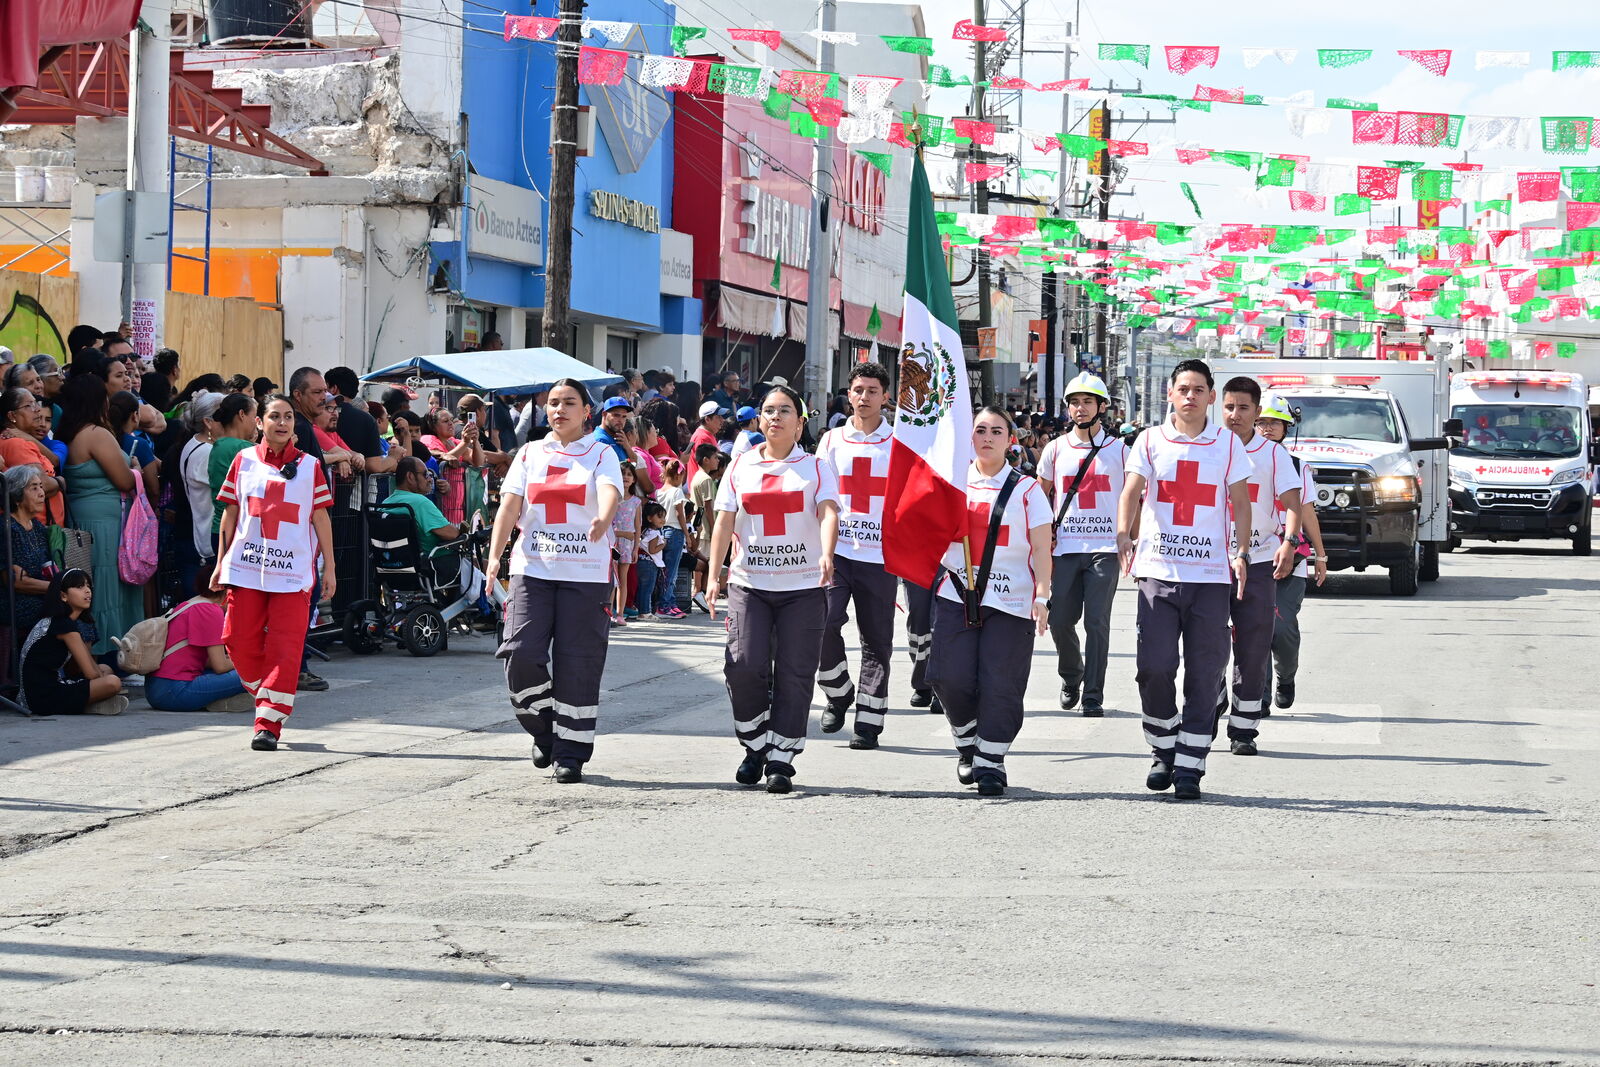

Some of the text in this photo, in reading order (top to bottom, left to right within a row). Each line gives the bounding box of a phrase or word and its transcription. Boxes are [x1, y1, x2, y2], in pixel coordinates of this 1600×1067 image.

[592, 189, 628, 224] SALINAS
[633, 199, 660, 234] ROCHA
[490, 211, 540, 244] Banco Azteca
[671, 257, 691, 279] Azteca
[861, 521, 882, 532] ROJ
[1064, 516, 1112, 524] CRUZ ROJA
[559, 533, 588, 542] ROJA
[1153, 532, 1212, 547] CRUZ ROJA
[243, 542, 294, 559] CRUZ ROJA
[530, 543, 588, 554] MEXICANA
[747, 543, 807, 554] CRUZ ROJA
[1152, 544, 1210, 559] MEXICANA
[240, 553, 293, 570] MEXCANA
[747, 555, 807, 567] MEXICANA
